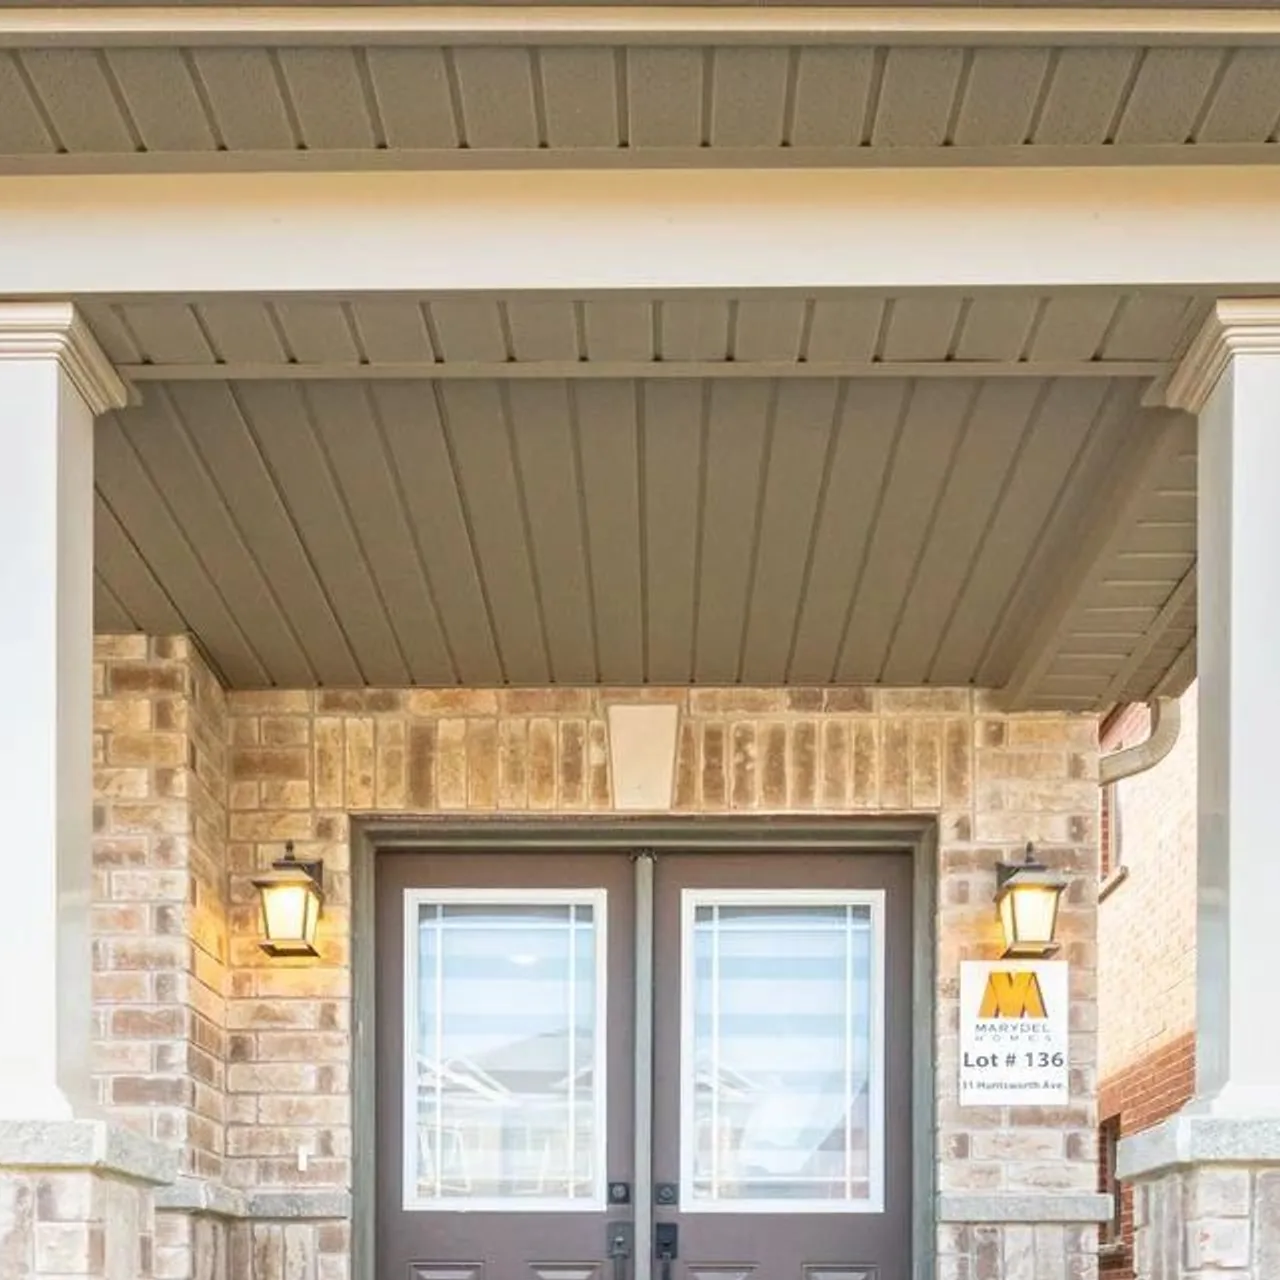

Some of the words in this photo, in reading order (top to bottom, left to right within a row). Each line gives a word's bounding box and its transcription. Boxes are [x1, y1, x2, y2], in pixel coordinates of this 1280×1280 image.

[975, 1023, 1051, 1033] MARYDEL
[974, 1034, 1052, 1042] HOMES
[964, 1051, 998, 1067] Lot
[1005, 1052, 1016, 1067] #
[1025, 1051, 1064, 1067] 136
